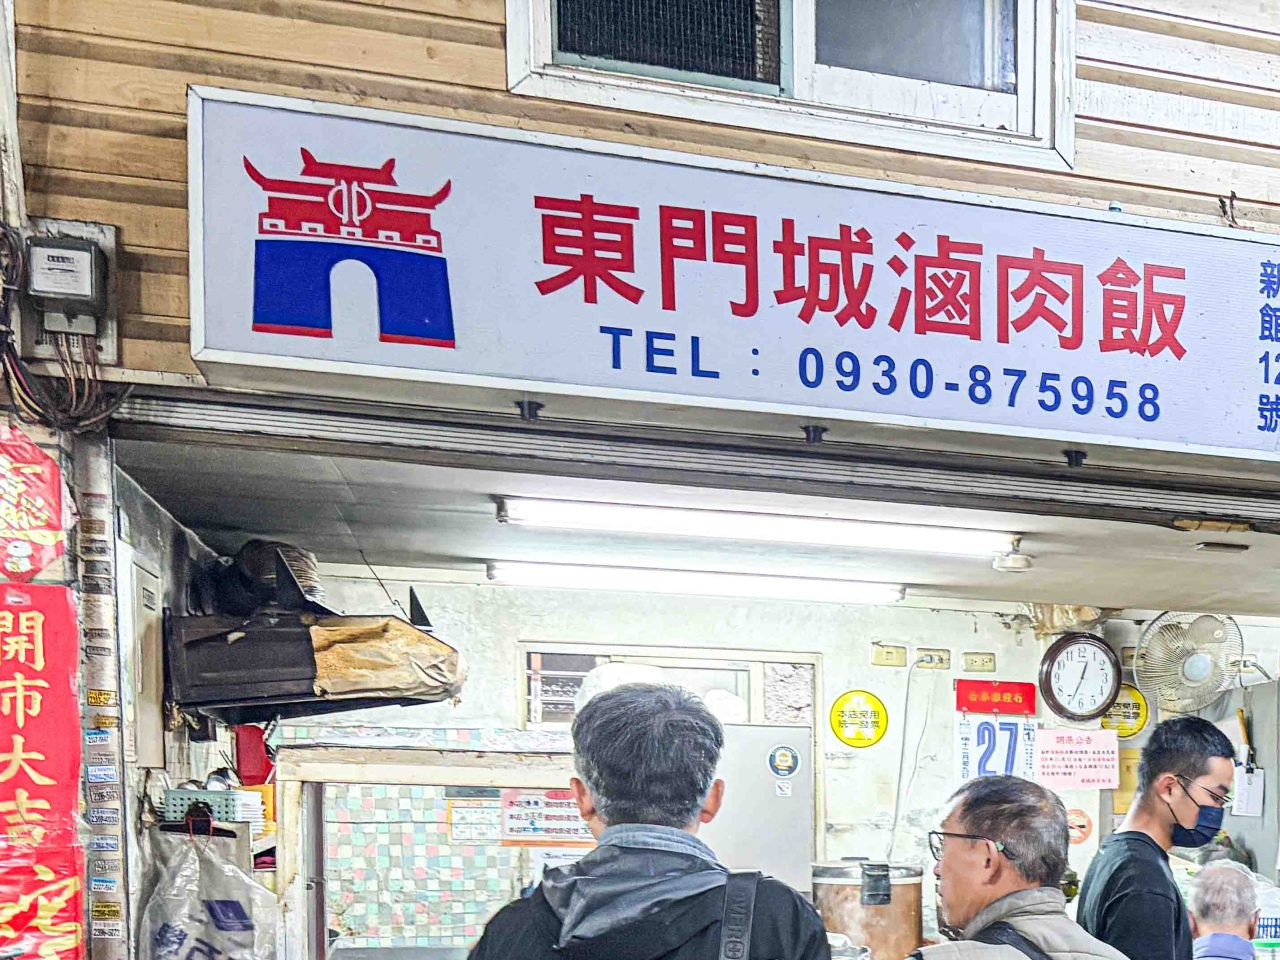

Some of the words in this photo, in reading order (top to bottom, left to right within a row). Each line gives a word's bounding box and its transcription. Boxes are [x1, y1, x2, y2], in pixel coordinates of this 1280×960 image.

[534, 194, 1187, 361] 東門城滷肉飯
[799, 347, 1161, 423] 0930-875958
[0, 610, 58, 846] 開市大吉
[976, 720, 1019, 777] 27
